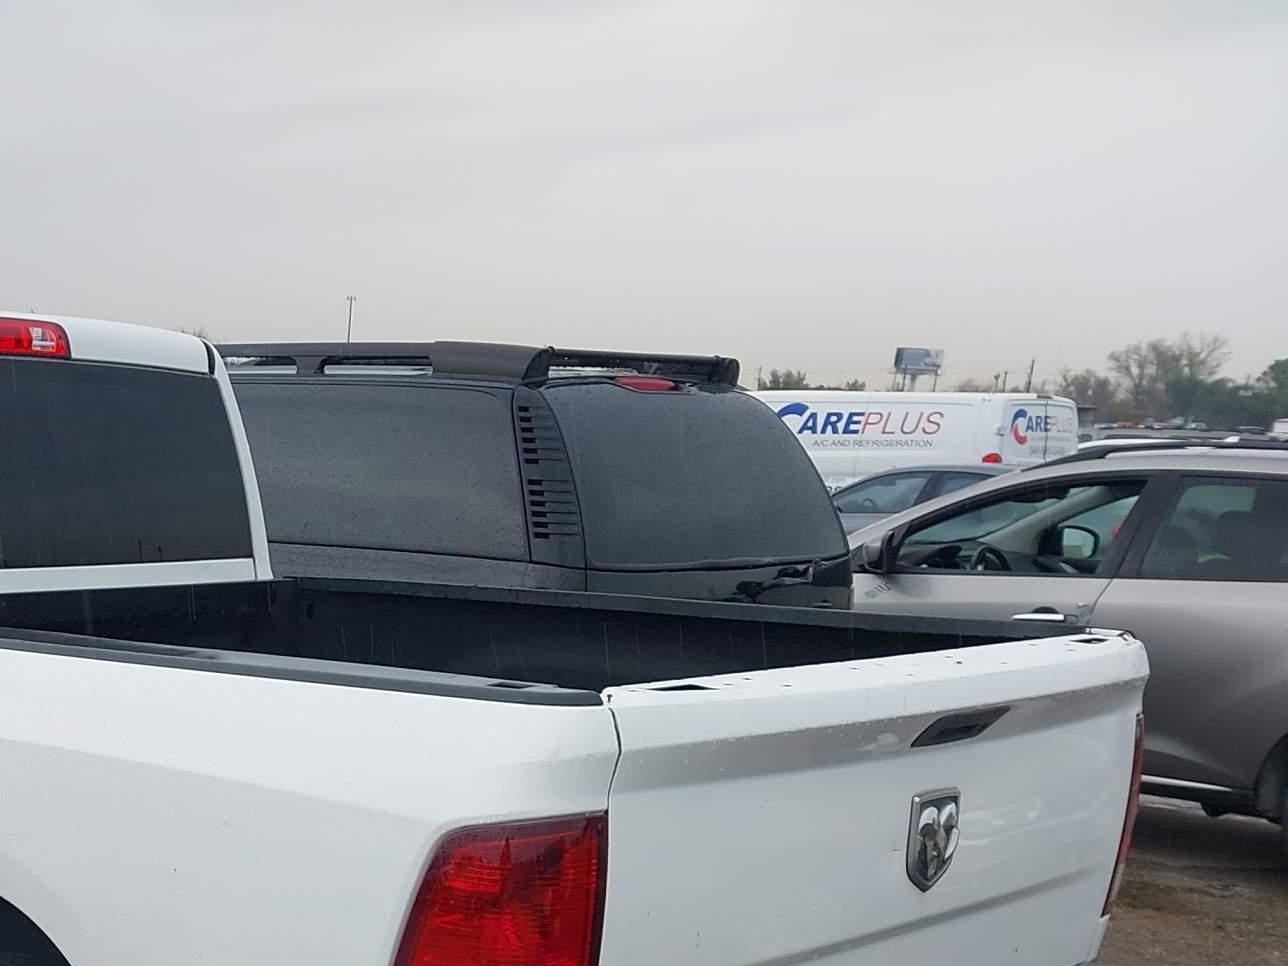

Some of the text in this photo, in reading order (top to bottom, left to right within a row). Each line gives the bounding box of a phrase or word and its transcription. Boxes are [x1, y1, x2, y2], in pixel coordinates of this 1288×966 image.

[812, 439, 934, 448] A/C AND REFRIGERATION
